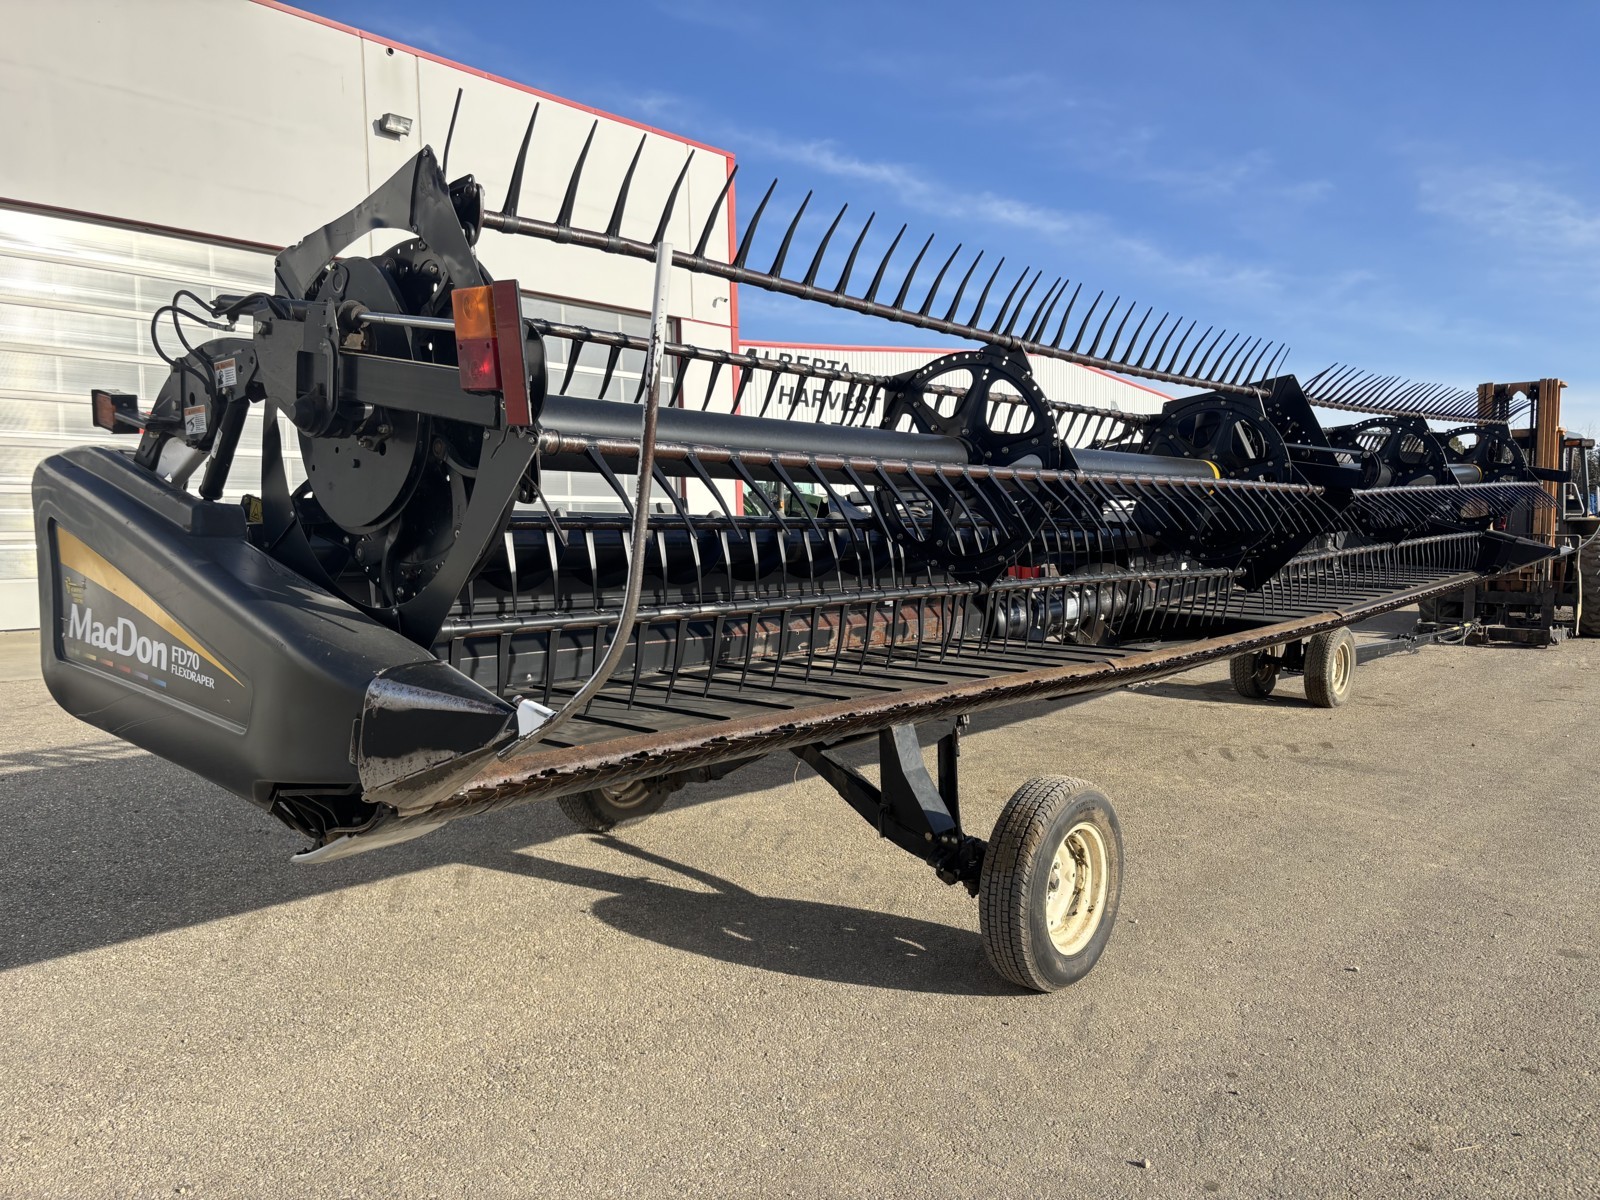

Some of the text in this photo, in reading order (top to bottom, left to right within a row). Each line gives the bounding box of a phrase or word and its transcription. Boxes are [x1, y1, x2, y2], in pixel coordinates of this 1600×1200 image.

[68, 603, 200, 671] MacDon FD70
[171, 664, 215, 689] FLEXDRAPER
